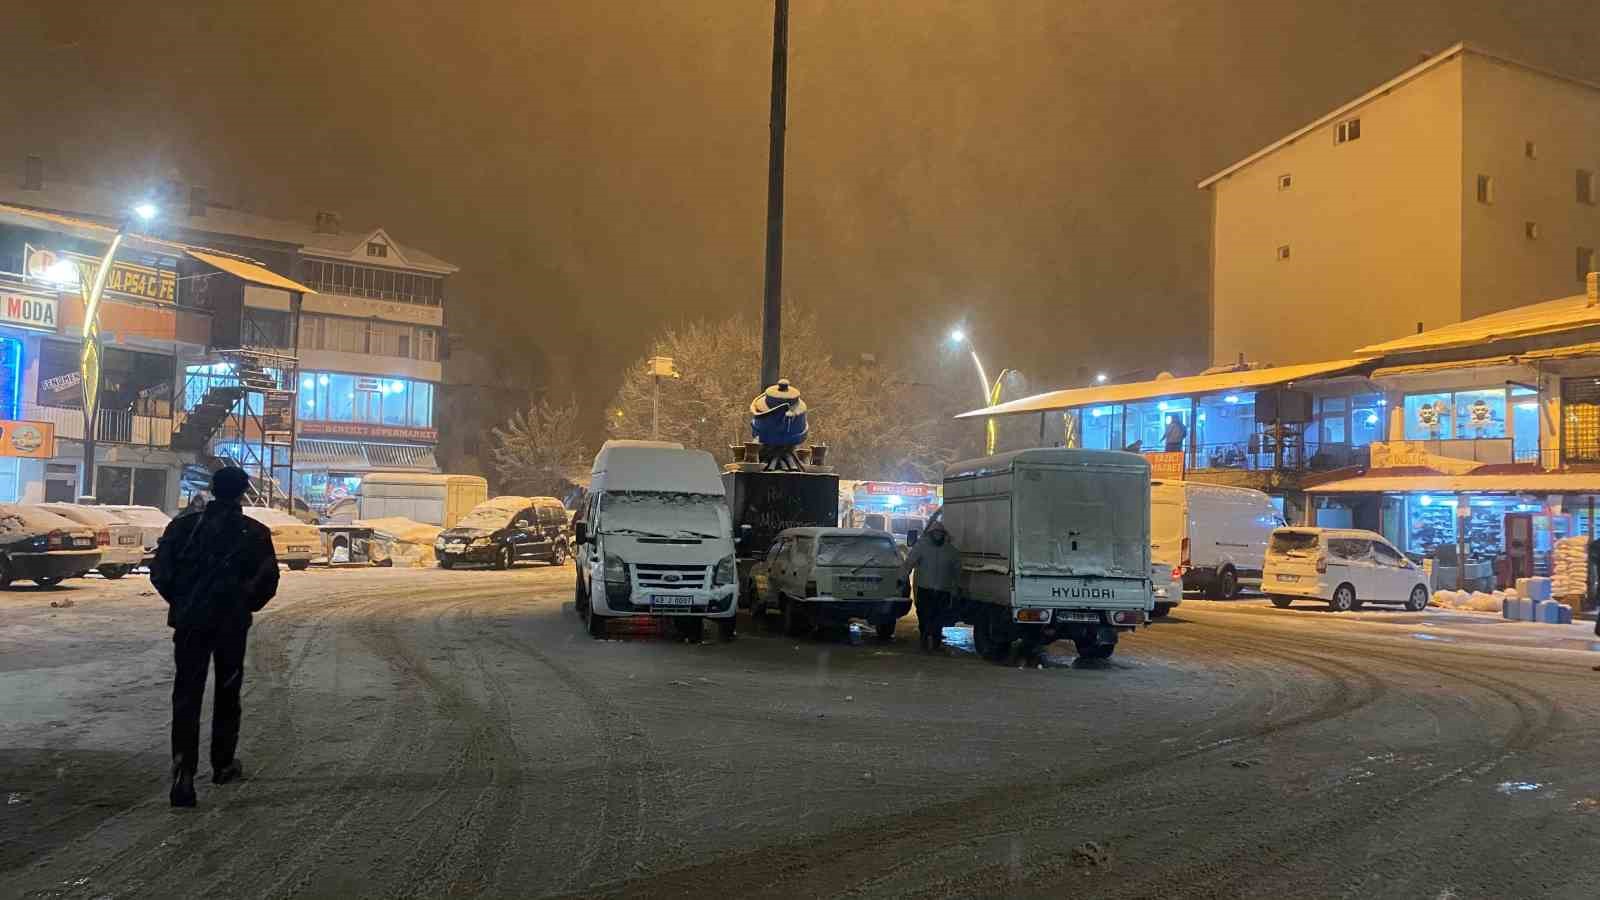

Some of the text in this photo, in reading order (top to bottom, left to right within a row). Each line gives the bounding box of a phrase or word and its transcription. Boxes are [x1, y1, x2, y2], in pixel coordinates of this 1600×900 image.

[147, 276, 174, 302] CFE
[8, 297, 53, 324] MODA
[1052, 587, 1115, 599] HYUNDAI
